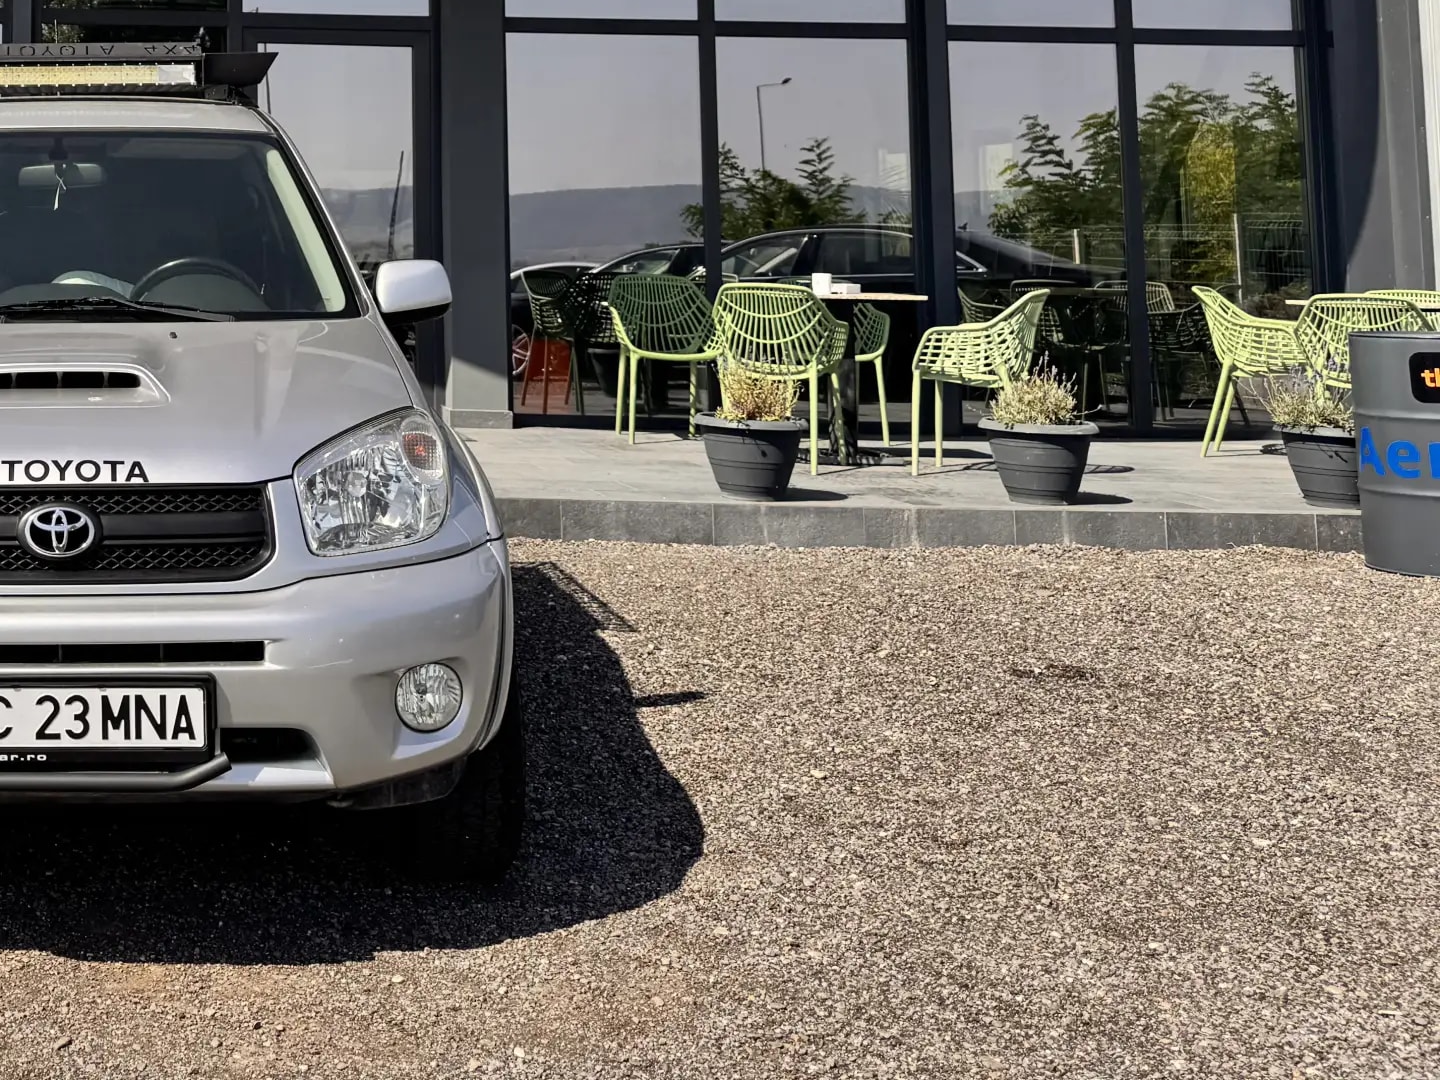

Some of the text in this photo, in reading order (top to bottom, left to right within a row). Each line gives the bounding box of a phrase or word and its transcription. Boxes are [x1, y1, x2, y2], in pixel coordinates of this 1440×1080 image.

[1, 459, 149, 483] TOYOTA
[34, 695, 90, 740] 23
[101, 694, 196, 740] MNA
